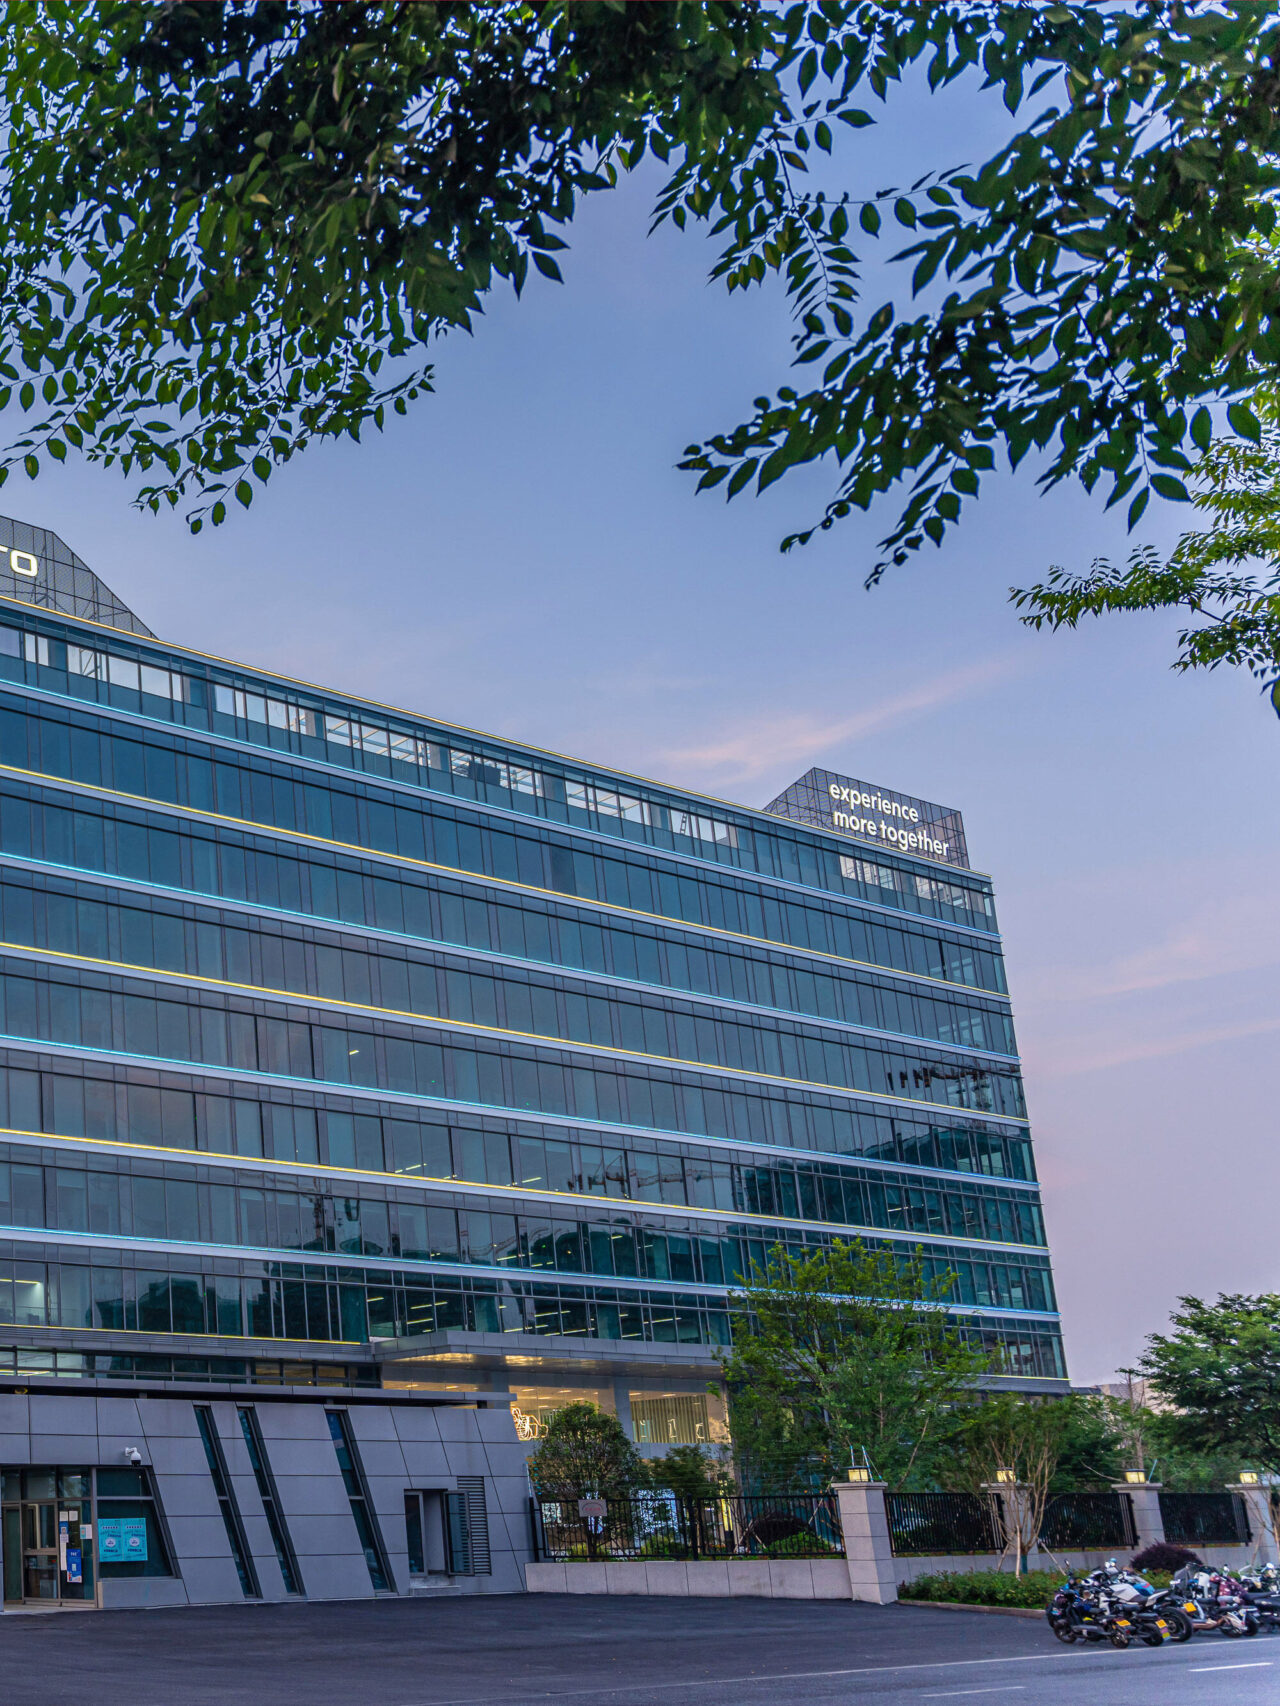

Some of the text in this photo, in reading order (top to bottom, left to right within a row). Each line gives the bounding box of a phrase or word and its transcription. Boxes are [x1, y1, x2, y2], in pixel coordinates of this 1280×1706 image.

[829, 783, 919, 823] experience
[833, 810, 949, 857] more together
